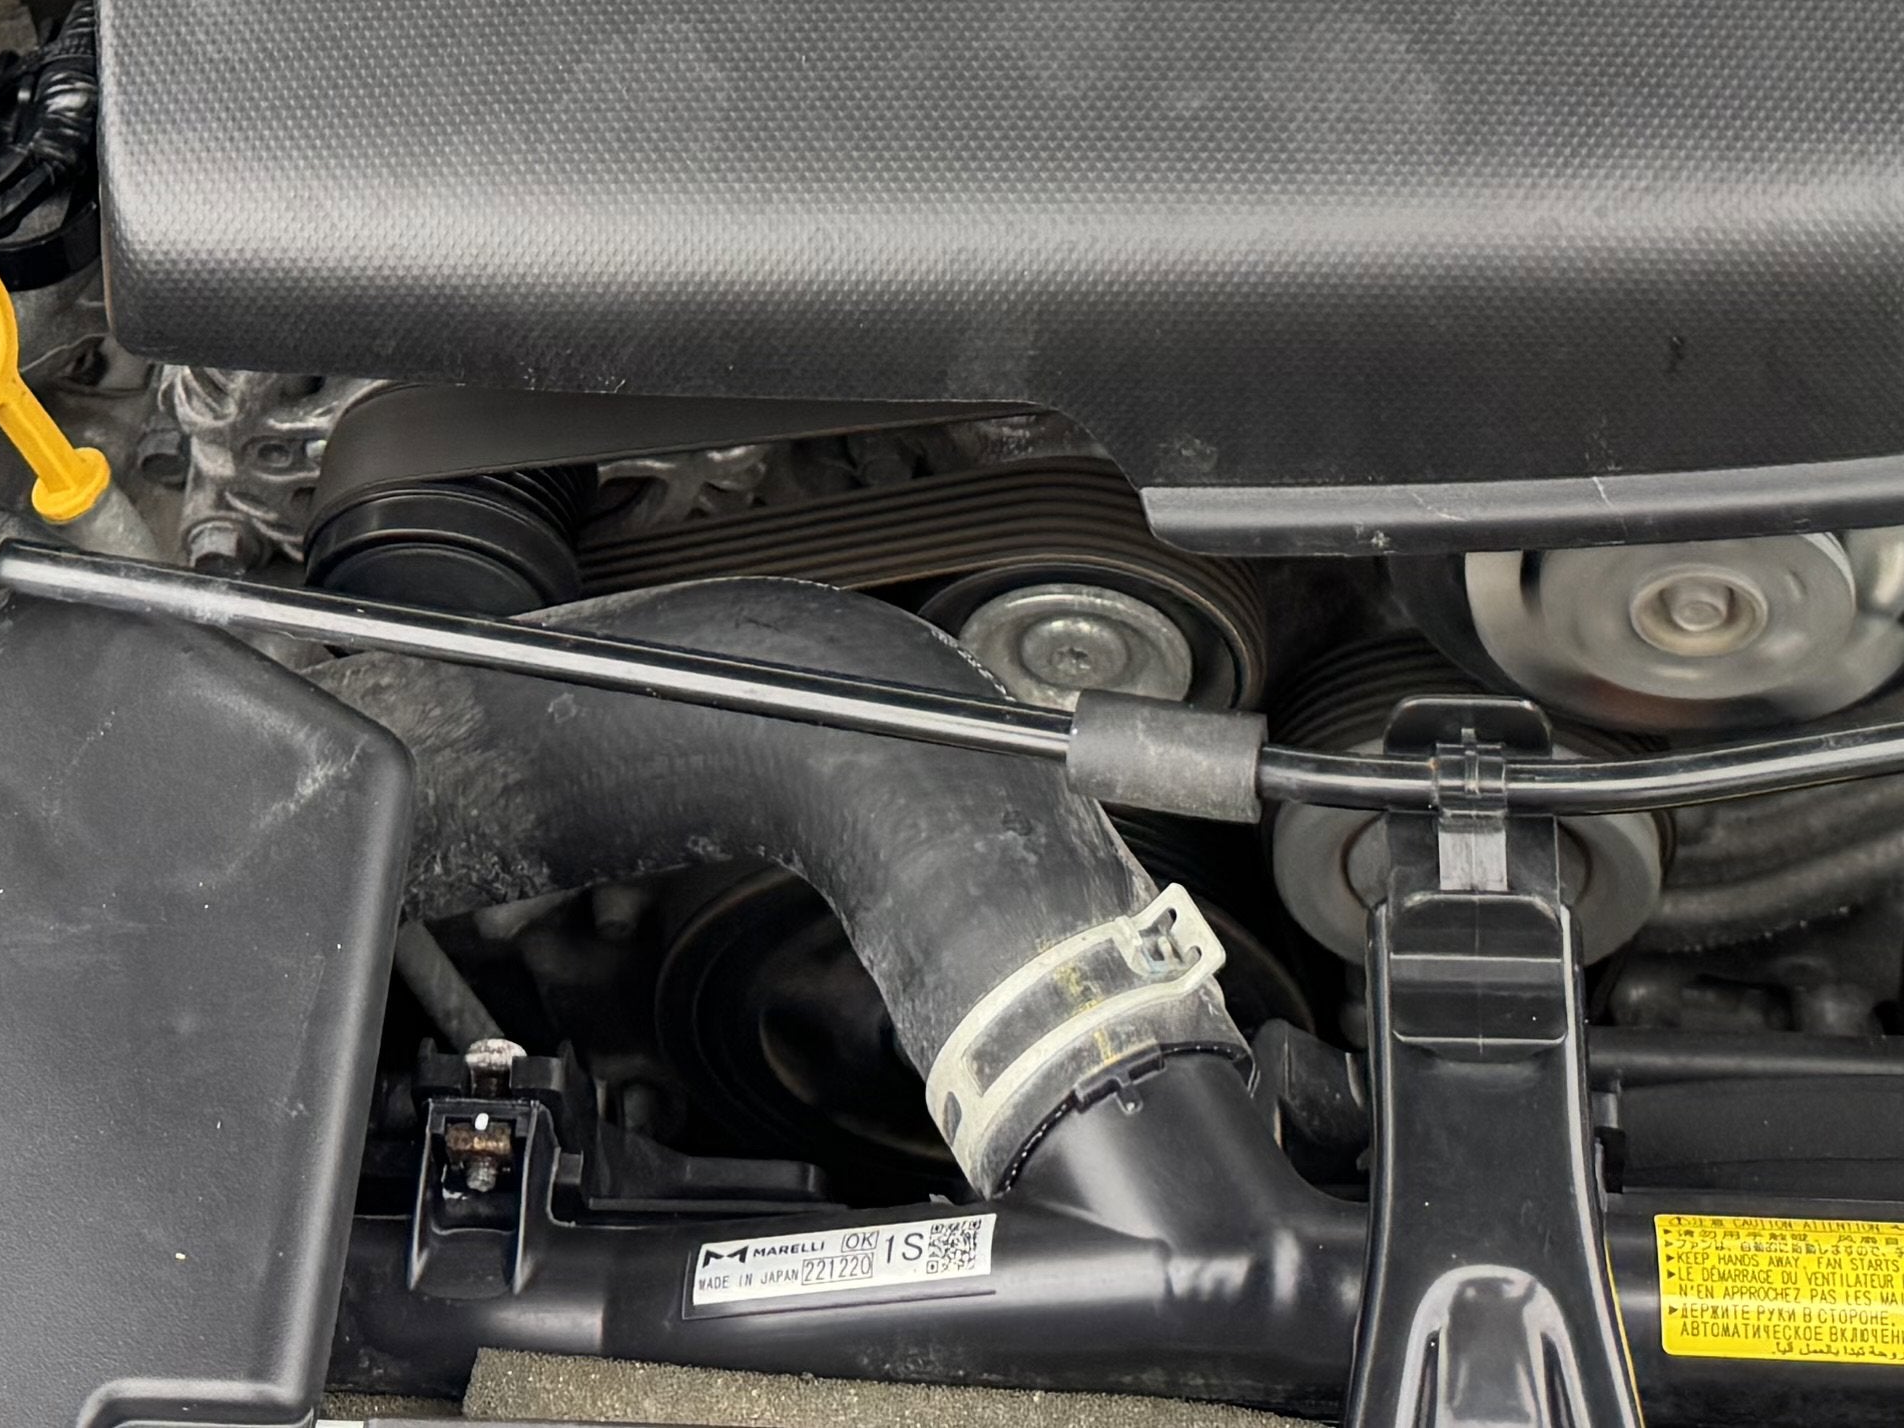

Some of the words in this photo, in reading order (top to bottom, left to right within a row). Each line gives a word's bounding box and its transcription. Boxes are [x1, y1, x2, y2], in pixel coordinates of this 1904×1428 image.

[753, 1242, 825, 1258] MARELLI
[845, 1233, 875, 1249] OK
[699, 1275, 729, 1291] MADE
[738, 1273, 753, 1287] IN
[760, 1269, 799, 1285] JAPAN
[803, 1256, 872, 1281] 221220
[1677, 1252, 1709, 1265] KEEP
[1718, 1254, 1759, 1267] HANDS
[1768, 1256, 1807, 1270] AWAY.
[1818, 1257, 1842, 1270] FAN
[1851, 1258, 1900, 1272] STARTS
[1678, 1267, 1693, 1281] LE
[1702, 1265, 1772, 1285] DÉMARRAGE
[1782, 1271, 1797, 1284] DU
[1807, 1272, 1894, 1288] VENTILATEUR
[1679, 1284, 1713, 1299] N'EN
[1723, 1286, 1800, 1303] APPROCHEZ
[1811, 1289, 1837, 1304] PAS
[1846, 1290, 1871, 1305] LES
[1681, 1303, 1751, 1321] ДЕРЖИТЕ
[1757, 1305, 1796, 1319] РУКИ
[1803, 1308, 1812, 1324] В
[1818, 1309, 1895, 1327] СТОРОНЕ.
[1680, 1321, 1823, 1342] АВТОМАТИЧЕСКОЕ
